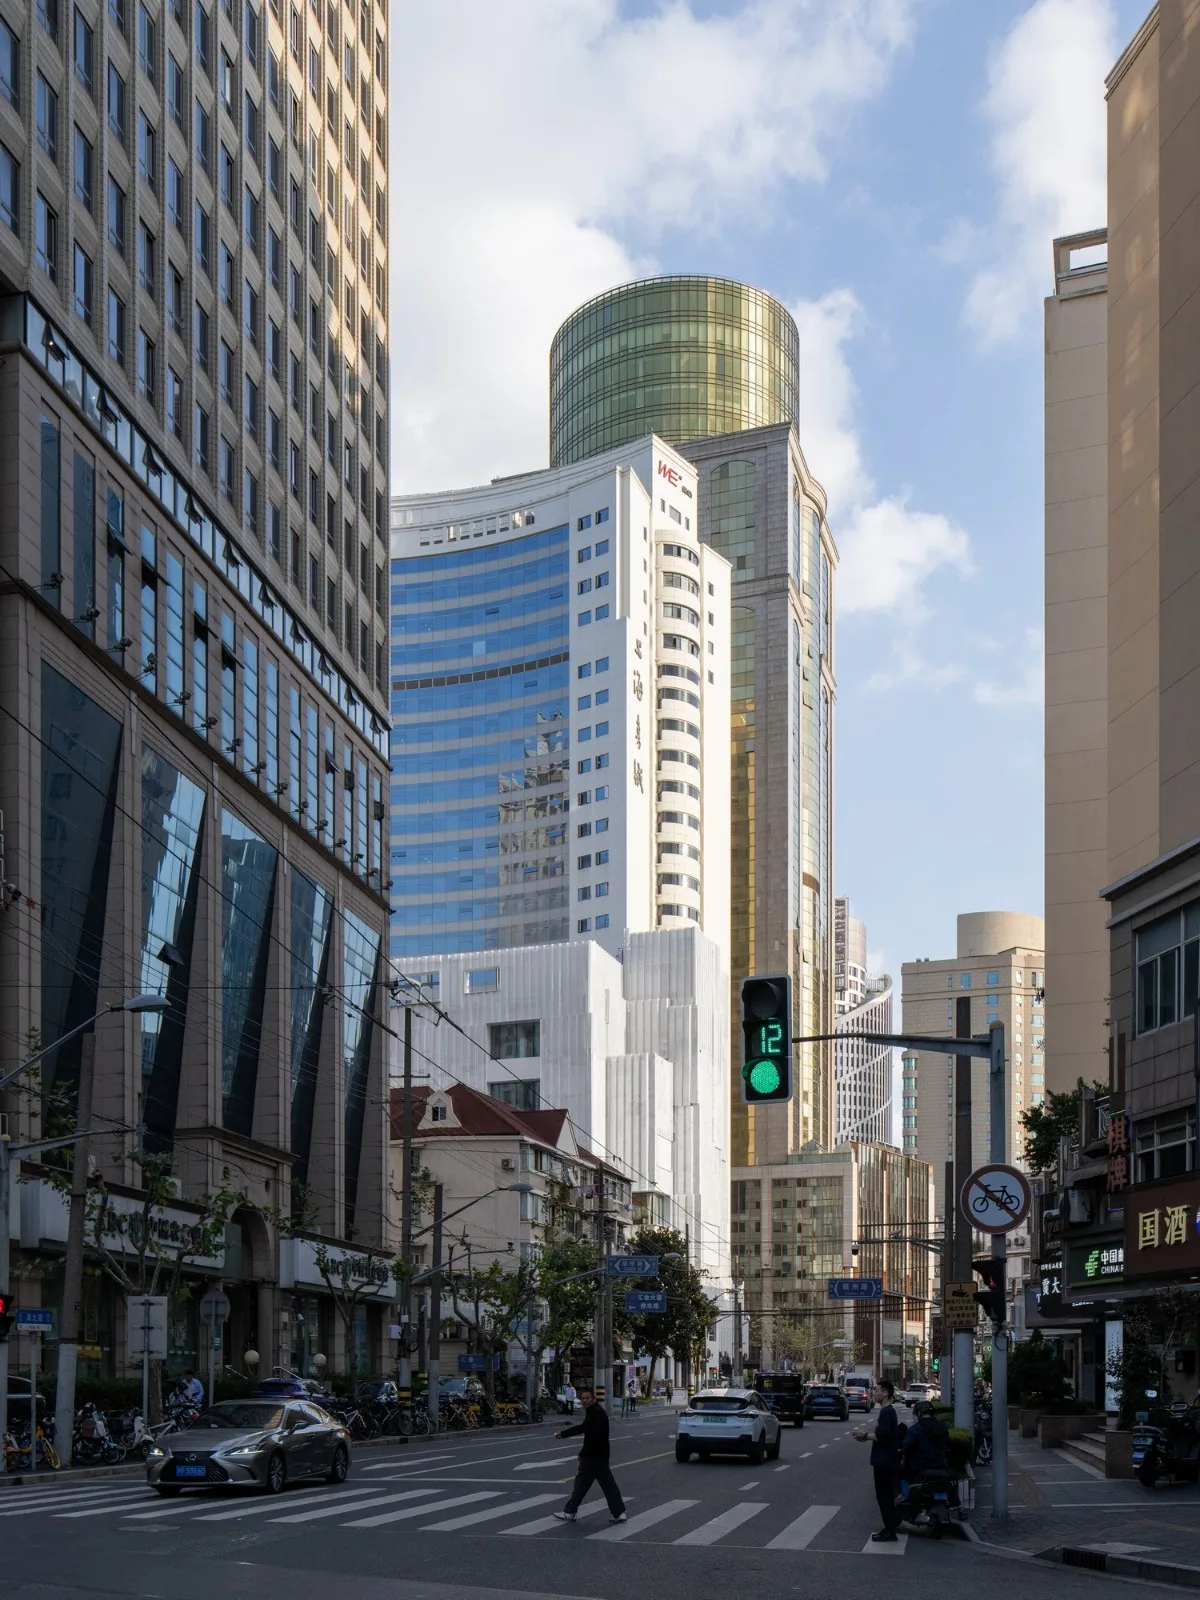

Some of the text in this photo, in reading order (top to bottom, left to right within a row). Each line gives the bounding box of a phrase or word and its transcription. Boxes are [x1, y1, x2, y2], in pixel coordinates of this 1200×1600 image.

[761, 1024, 782, 1054] 12
[1107, 1115, 1128, 1193] 棋牌
[1138, 1204, 1191, 1251] 国酒
[1100, 1265, 1119, 1275] CHINA
